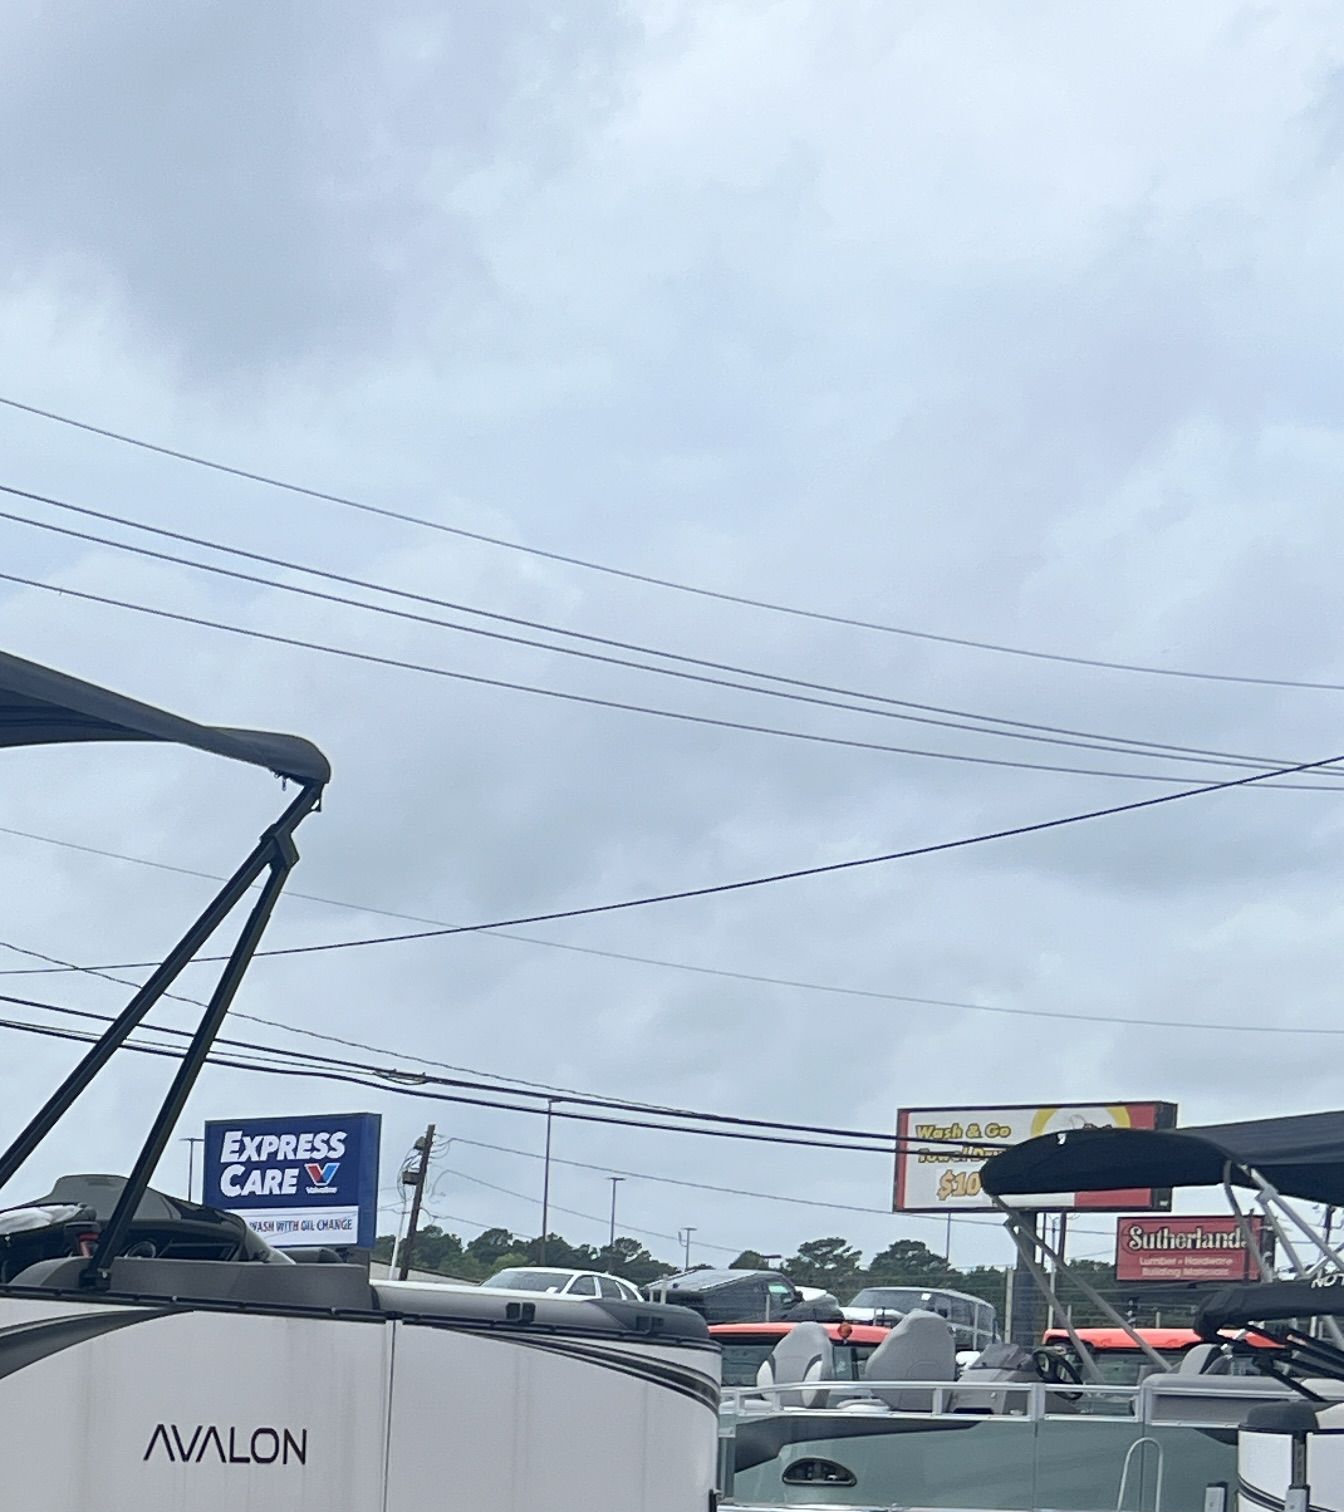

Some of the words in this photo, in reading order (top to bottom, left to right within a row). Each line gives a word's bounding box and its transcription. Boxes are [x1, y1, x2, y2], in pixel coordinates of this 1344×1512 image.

[220, 1130, 348, 1163] EXPRESS
[915, 1123, 962, 1140] Wash
[966, 1123, 983, 1138] &
[985, 1123, 1012, 1138] Go
[220, 1163, 300, 1197] CARE
[276, 1220, 300, 1233] WITH
[300, 1219, 315, 1232] OIL
[316, 1217, 353, 1232] CHANGE
[143, 1423, 308, 1466] AVALON
